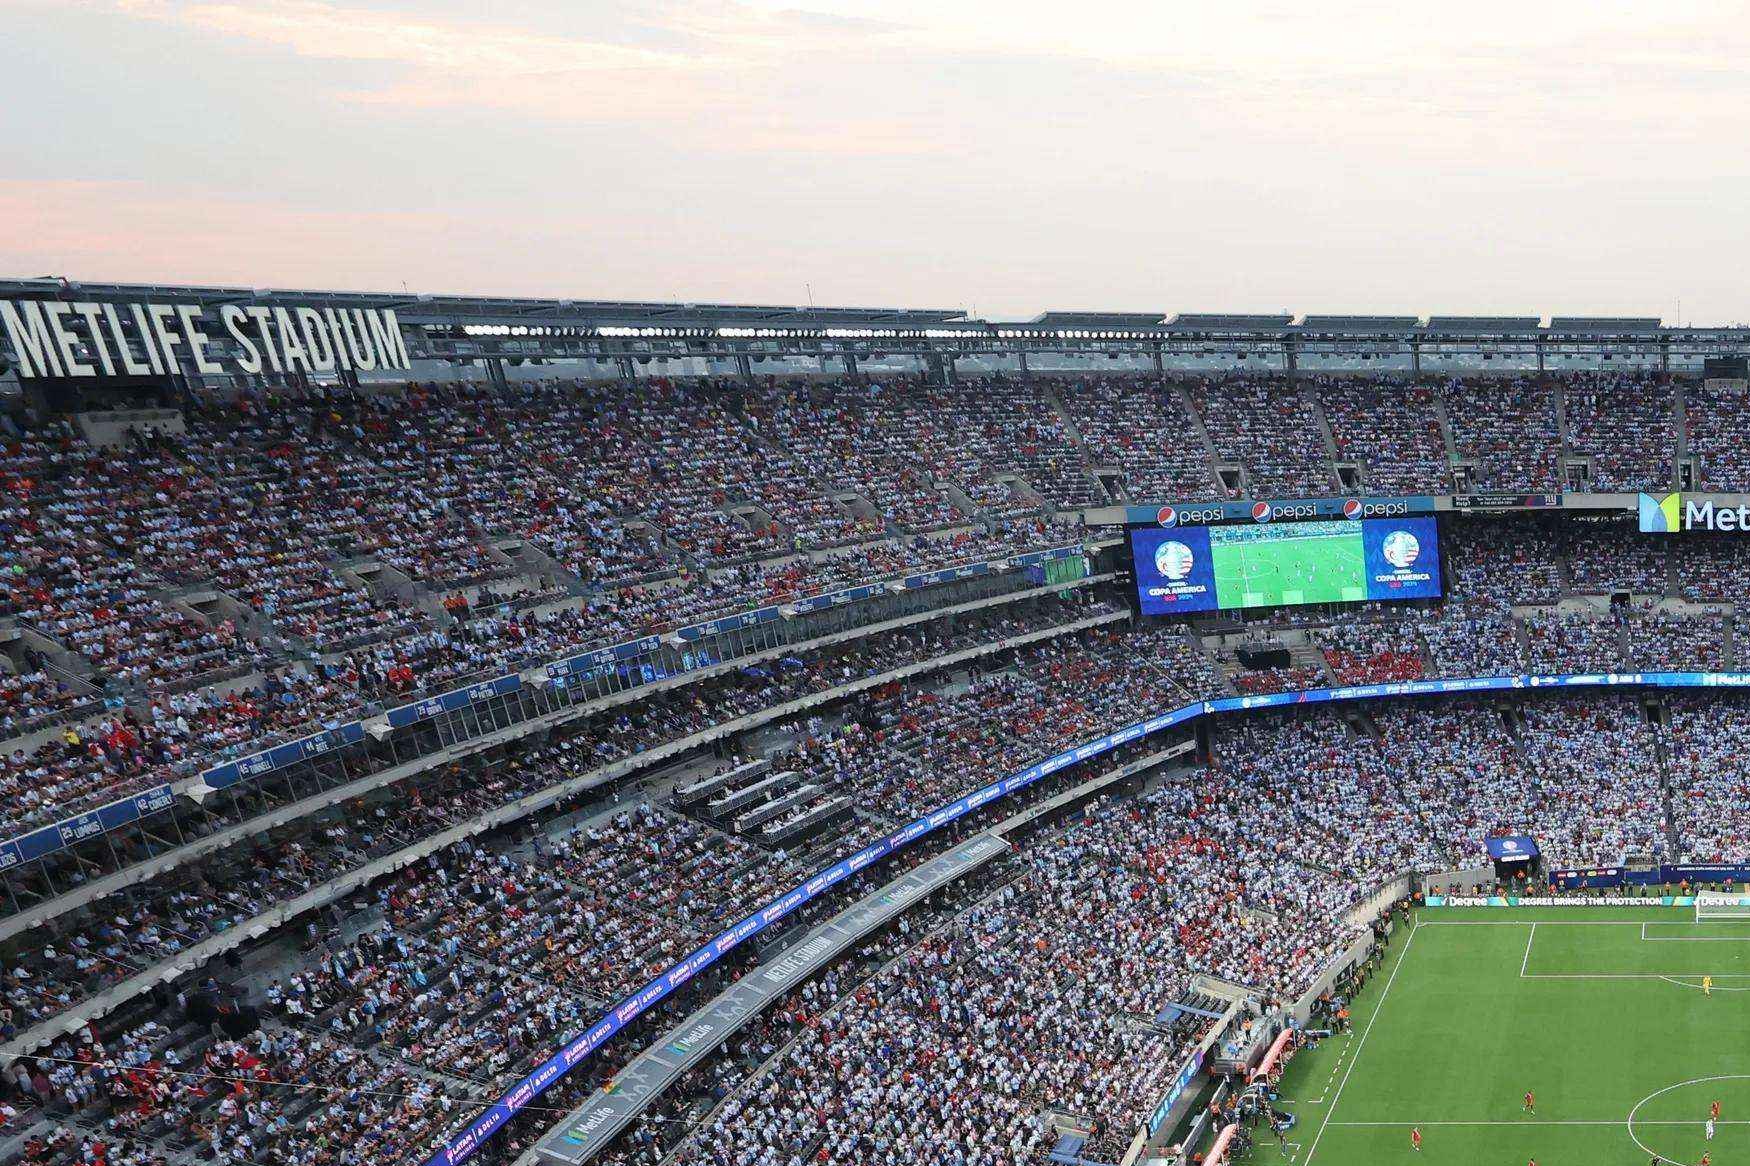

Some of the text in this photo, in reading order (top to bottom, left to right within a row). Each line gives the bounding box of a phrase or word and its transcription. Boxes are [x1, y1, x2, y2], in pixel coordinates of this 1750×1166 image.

[0, 300, 410, 377] METLIFE STADIUM
[1179, 506, 1224, 525] pepsi
[1273, 502, 1317, 519] pepsi
[1364, 500, 1408, 517] pepsi
[1149, 587, 1172, 596] COPA
[1451, 896, 1488, 907] Degree
[1519, 897, 1663, 906] DEGREE BRINGS THE PROTECTION
[763, 936, 833, 982] METLIFE STADIUM
[684, 1021, 714, 1049] MetLife
[539, 1066, 558, 1083] DELTA
[482, 1113, 500, 1131] DELTA
[578, 1106, 615, 1134] MetLife
[451, 1134, 473, 1154] LATAM
